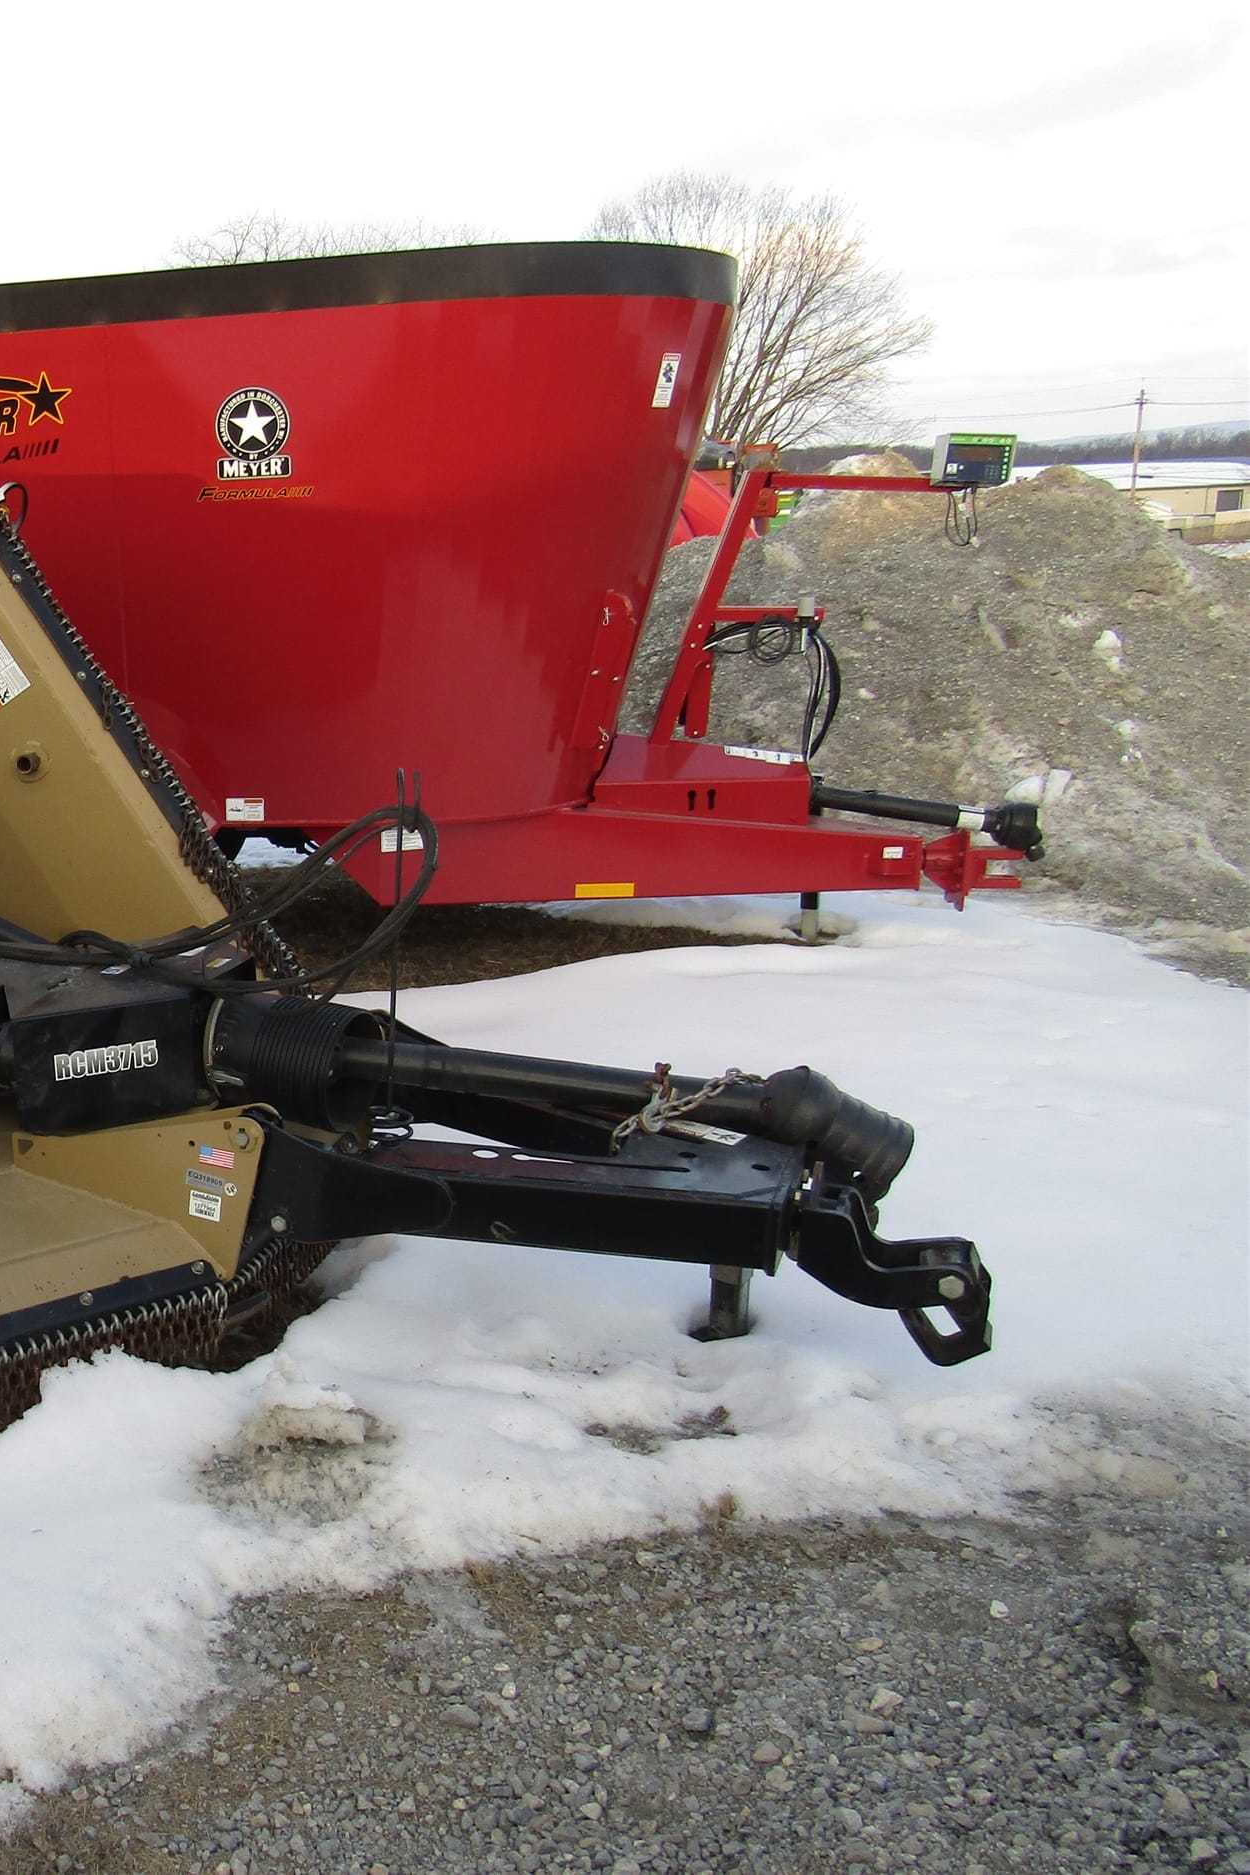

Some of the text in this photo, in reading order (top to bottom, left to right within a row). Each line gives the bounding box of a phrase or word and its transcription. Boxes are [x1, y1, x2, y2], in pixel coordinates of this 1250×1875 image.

[219, 393, 246, 443] MANUFACTURED
[256, 391, 286, 429] DORCHESTER
[222, 458, 282, 478] MEYER
[54, 1040, 159, 1081] RCM3715
